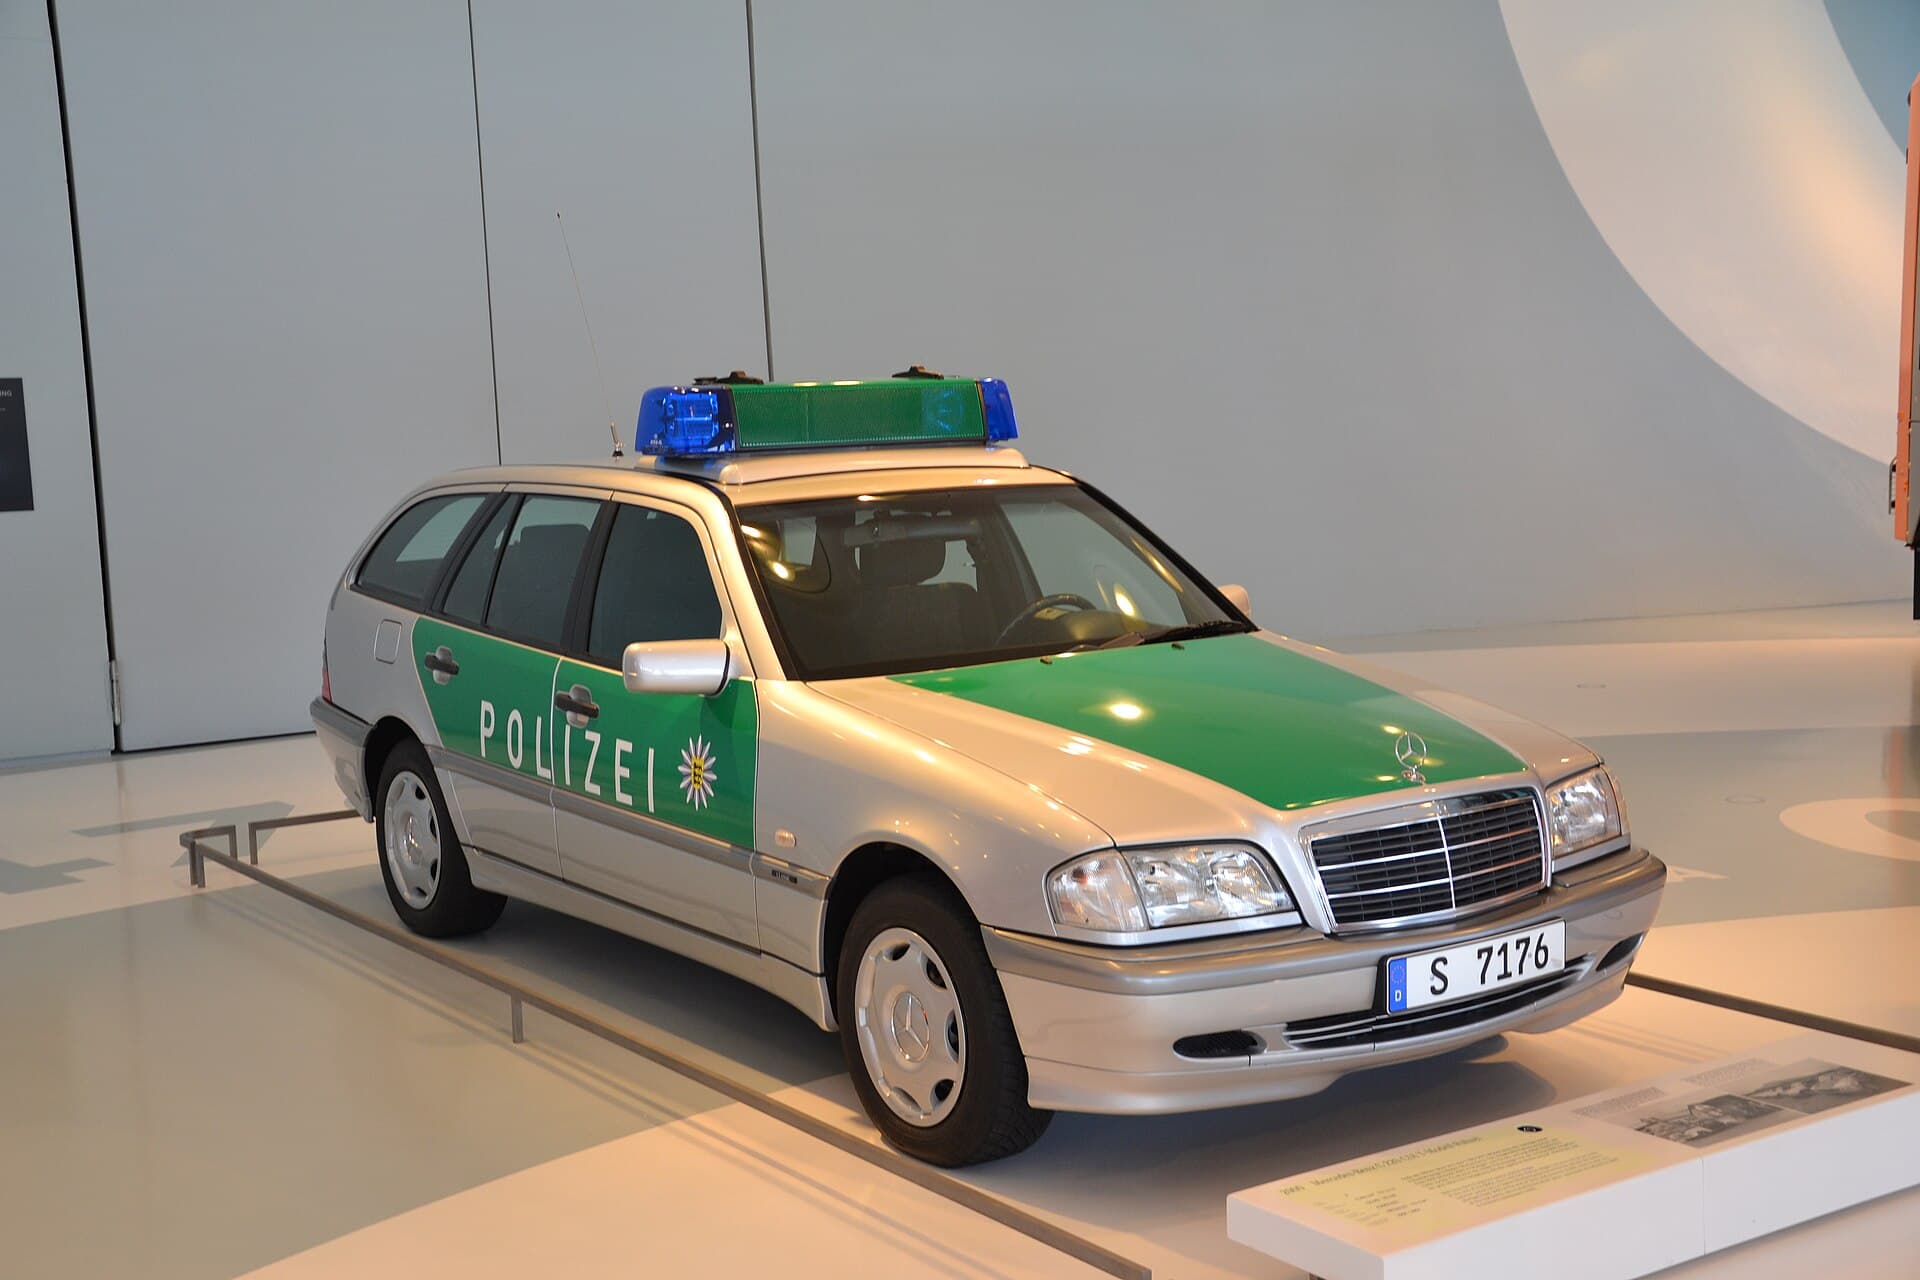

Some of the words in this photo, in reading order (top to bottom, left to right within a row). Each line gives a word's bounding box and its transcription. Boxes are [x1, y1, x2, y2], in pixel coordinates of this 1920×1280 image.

[480, 700, 655, 813] POLIZEI
[1430, 957, 1448, 995] S
[1477, 933, 1549, 985] 7176
[1395, 990, 1402, 1002] D
